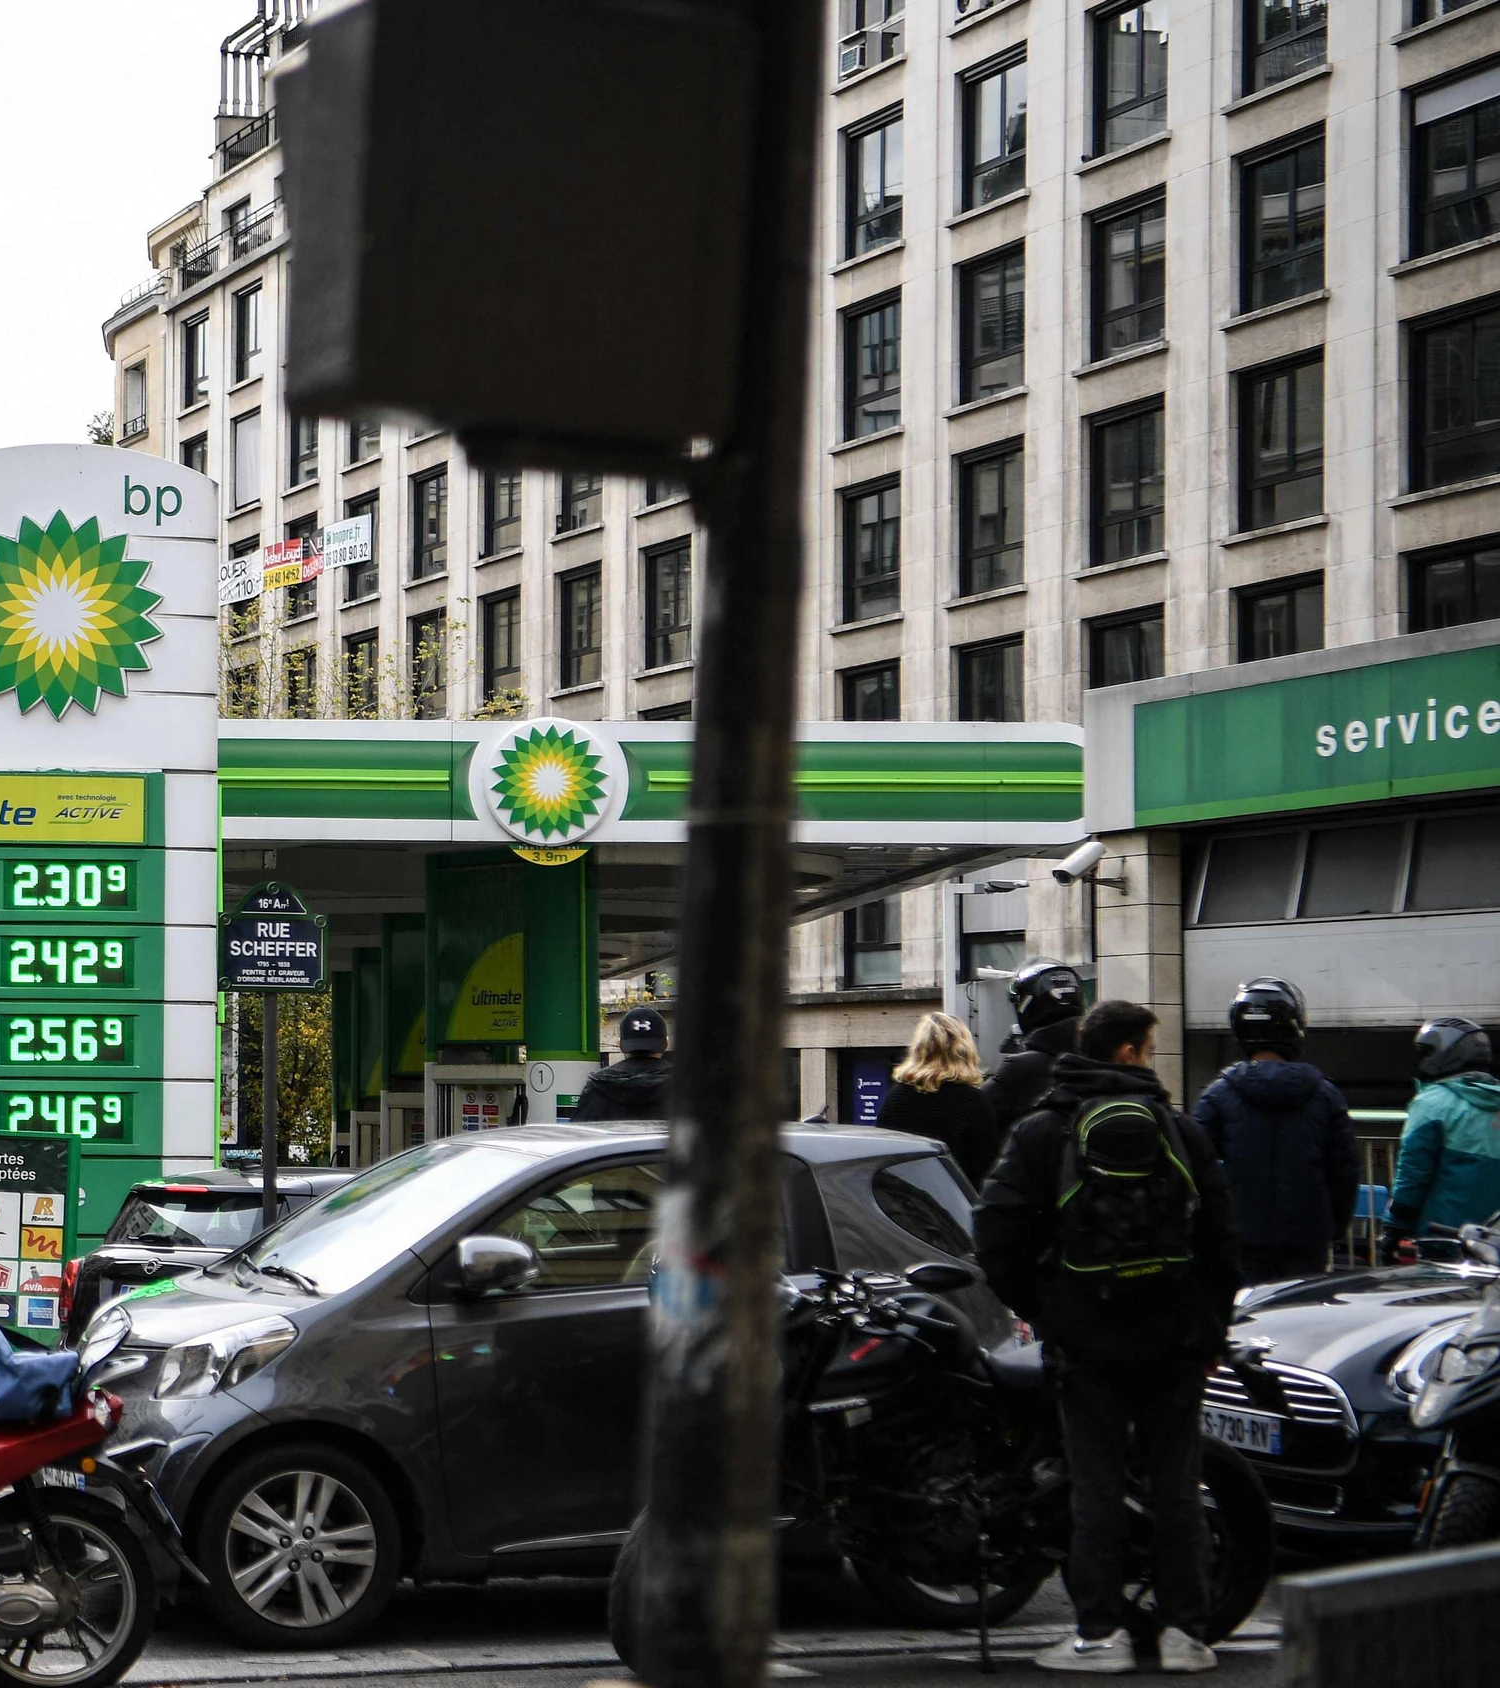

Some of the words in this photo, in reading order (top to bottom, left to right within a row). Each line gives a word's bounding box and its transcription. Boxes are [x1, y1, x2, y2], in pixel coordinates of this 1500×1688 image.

[124, 475, 183, 526] bp
[348, 544, 358, 560] 90
[359, 542, 368, 558] 32
[218, 560, 248, 582] OUER
[75, 793, 117, 803] technologie
[55, 806, 125, 820] ACTIVE
[532, 851, 568, 862] 3.9m
[257, 922, 291, 938] RUE
[230, 940, 318, 957] SCHEFFER
[472, 989, 522, 1006] ultimate
[1202, 1411, 1269, 1448] S-730-RV
